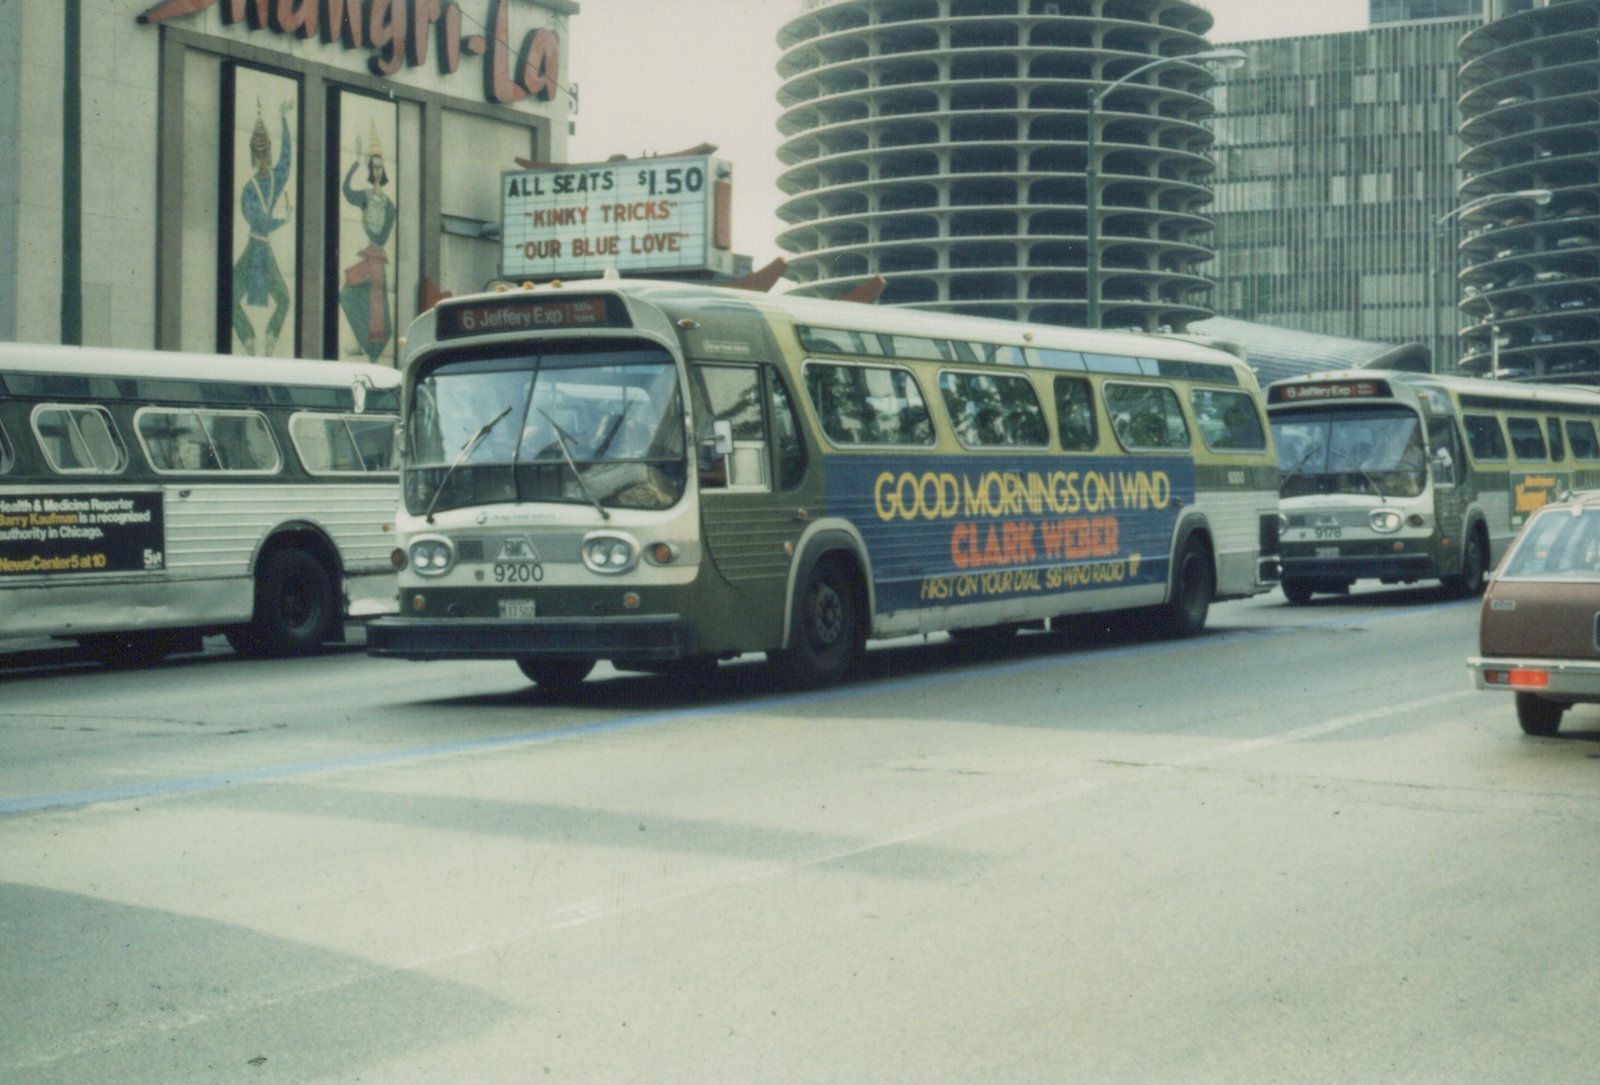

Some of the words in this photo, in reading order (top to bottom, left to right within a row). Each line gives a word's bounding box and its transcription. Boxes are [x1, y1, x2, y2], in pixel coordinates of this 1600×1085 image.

[508, 177, 545, 198] ALL
[552, 170, 614, 194] SEATS
[638, 166, 704, 196] $1.50
[524, 206, 589, 228] "KINKY
[601, 199, 678, 224] TRICKS"
[515, 239, 562, 260] "OUR
[571, 235, 620, 258] BLUE
[630, 231, 689, 255] LOVE"
[461, 309, 476, 330] 6
[479, 307, 531, 327] Jeffery
[533, 306, 564, 325] Exp
[33, 499, 42, 512] &
[43, 498, 89, 512] Medicine
[90, 497, 134, 513] Reporter
[874, 471, 960, 521] GOOD
[963, 470, 1080, 519] MORNINGS
[1082, 471, 1115, 513] ON
[1118, 470, 1170, 510] WIND
[78, 511, 88, 524] is
[89, 513, 97, 523] a
[97, 510, 151, 525] recognized
[48, 526, 58, 539] in
[59, 526, 104, 540] Chicago.
[950, 520, 1037, 569] CLARK
[1041, 515, 1120, 560] WEBER
[80, 554, 91, 568] at
[92, 553, 106, 568] 10
[493, 563, 544, 583] 9200
[920, 574, 954, 600] FIRST
[956, 574, 978, 598] ON
[980, 571, 1014, 595] YOUR
[1014, 569, 1042, 593] DIAL
[1092, 561, 1126, 583] RADIO
